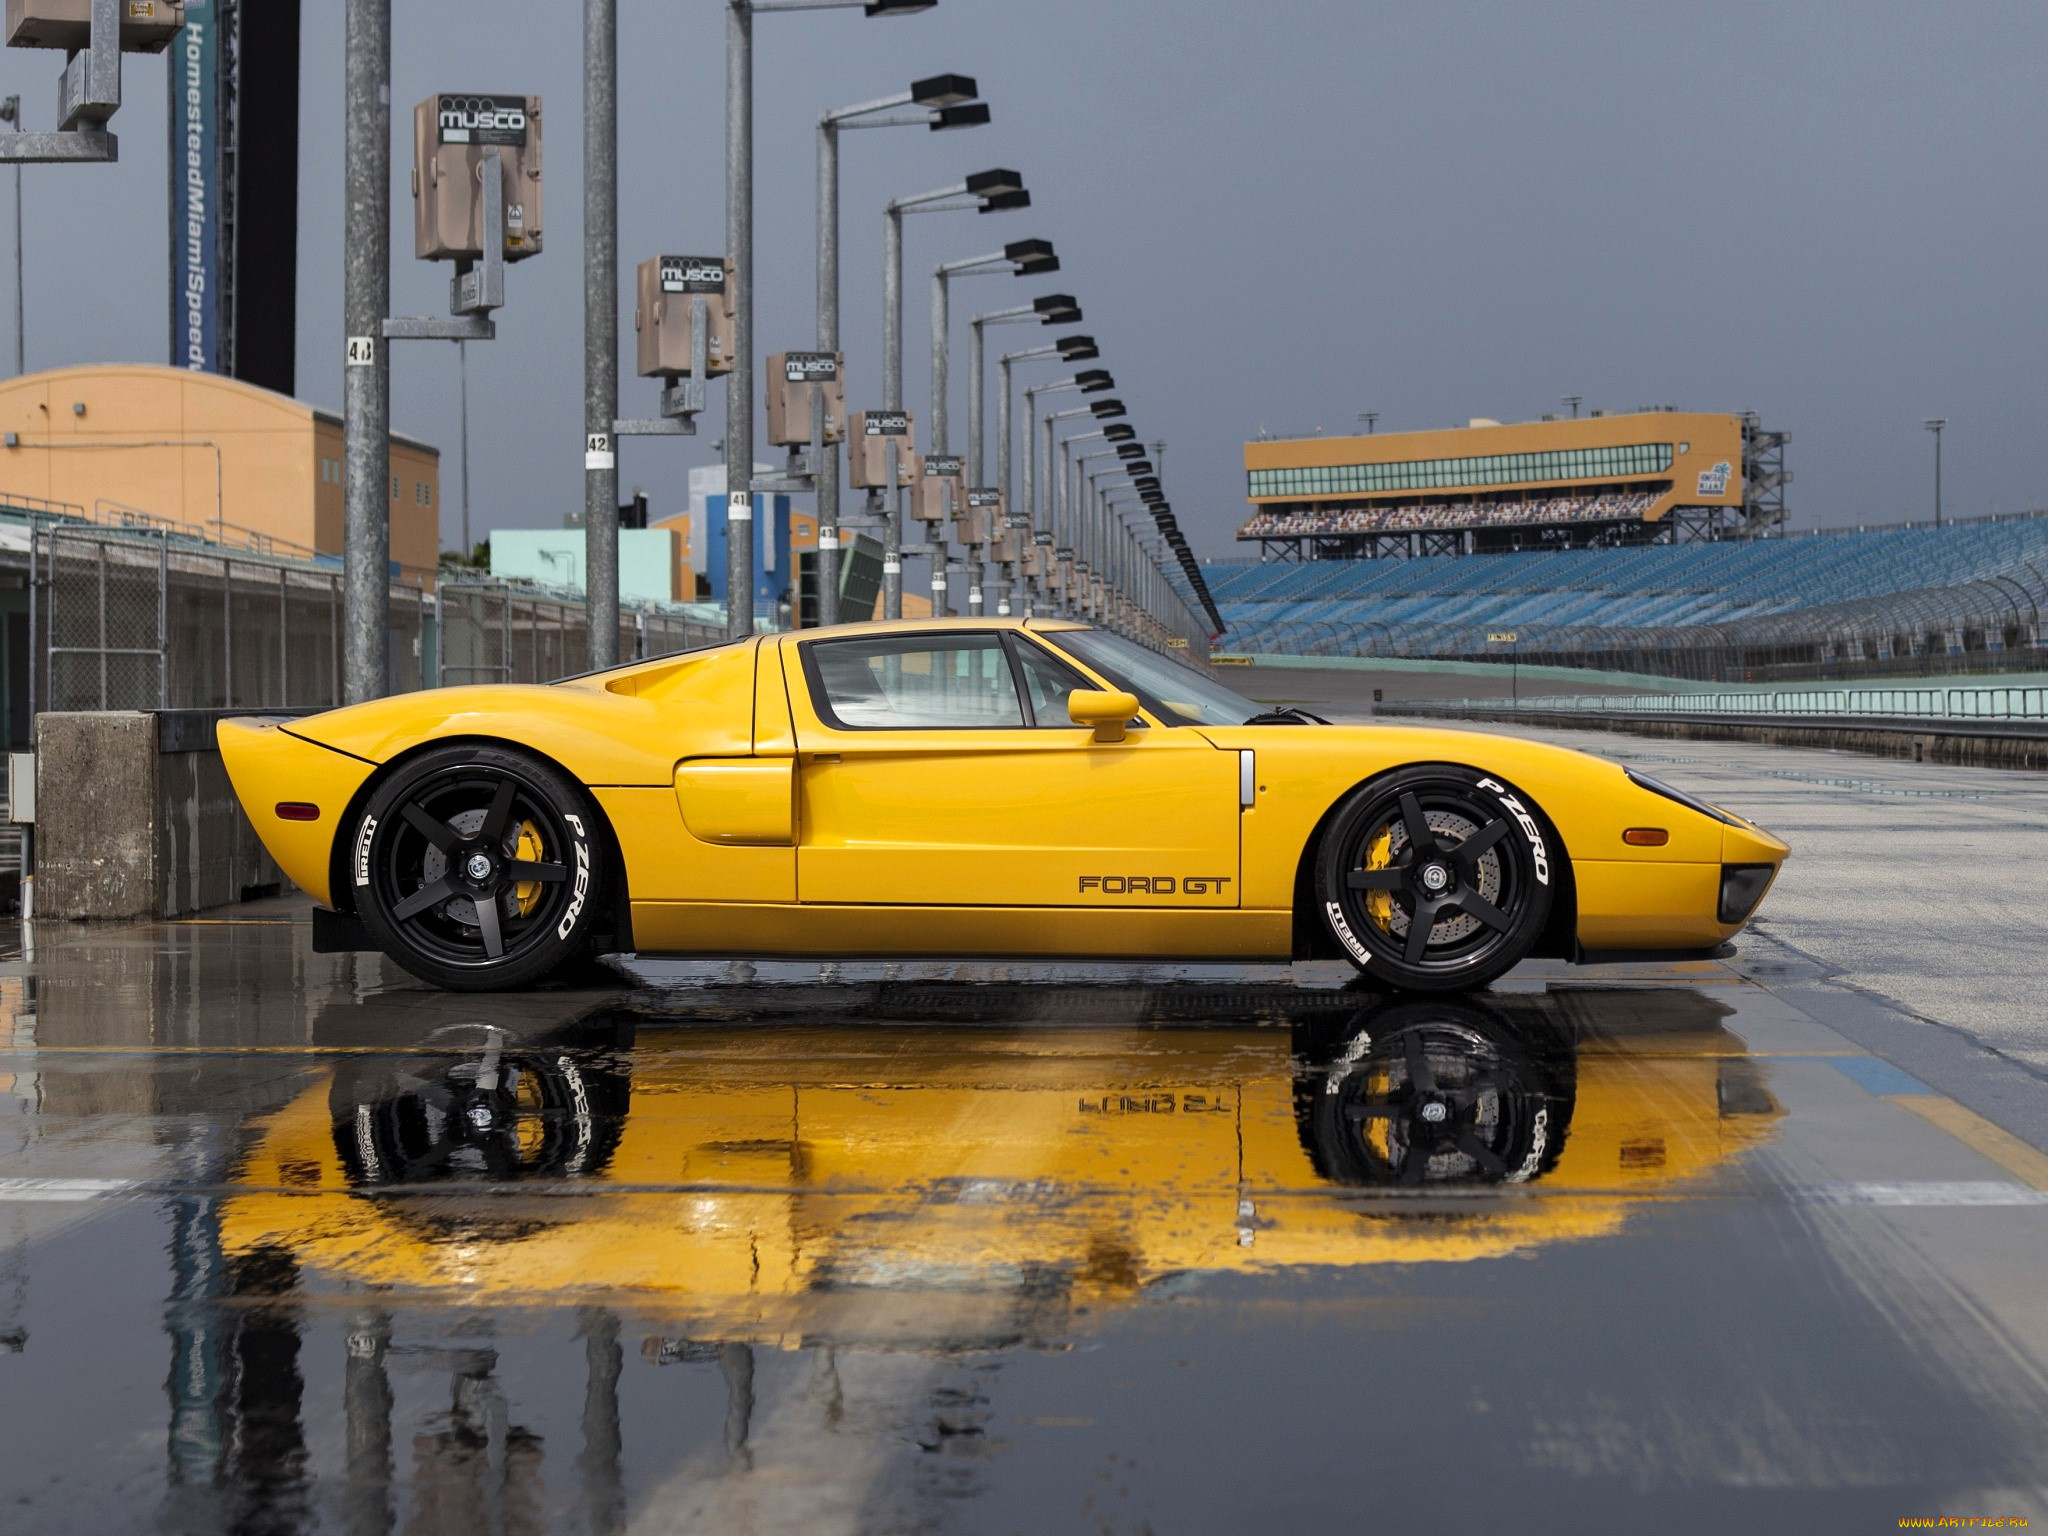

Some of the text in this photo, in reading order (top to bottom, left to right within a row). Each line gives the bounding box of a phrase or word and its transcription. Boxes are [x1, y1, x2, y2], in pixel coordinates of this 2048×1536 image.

[588, 437, 606, 451] 42
[733, 494, 745, 506] 41
[354, 814, 378, 887] PIRELLI
[1476, 777, 1549, 886] P ZERO
[557, 814, 590, 941] P ZERO
[1078, 875, 1232, 895] FORD GT
[1326, 901, 1373, 965] PIRELLI
